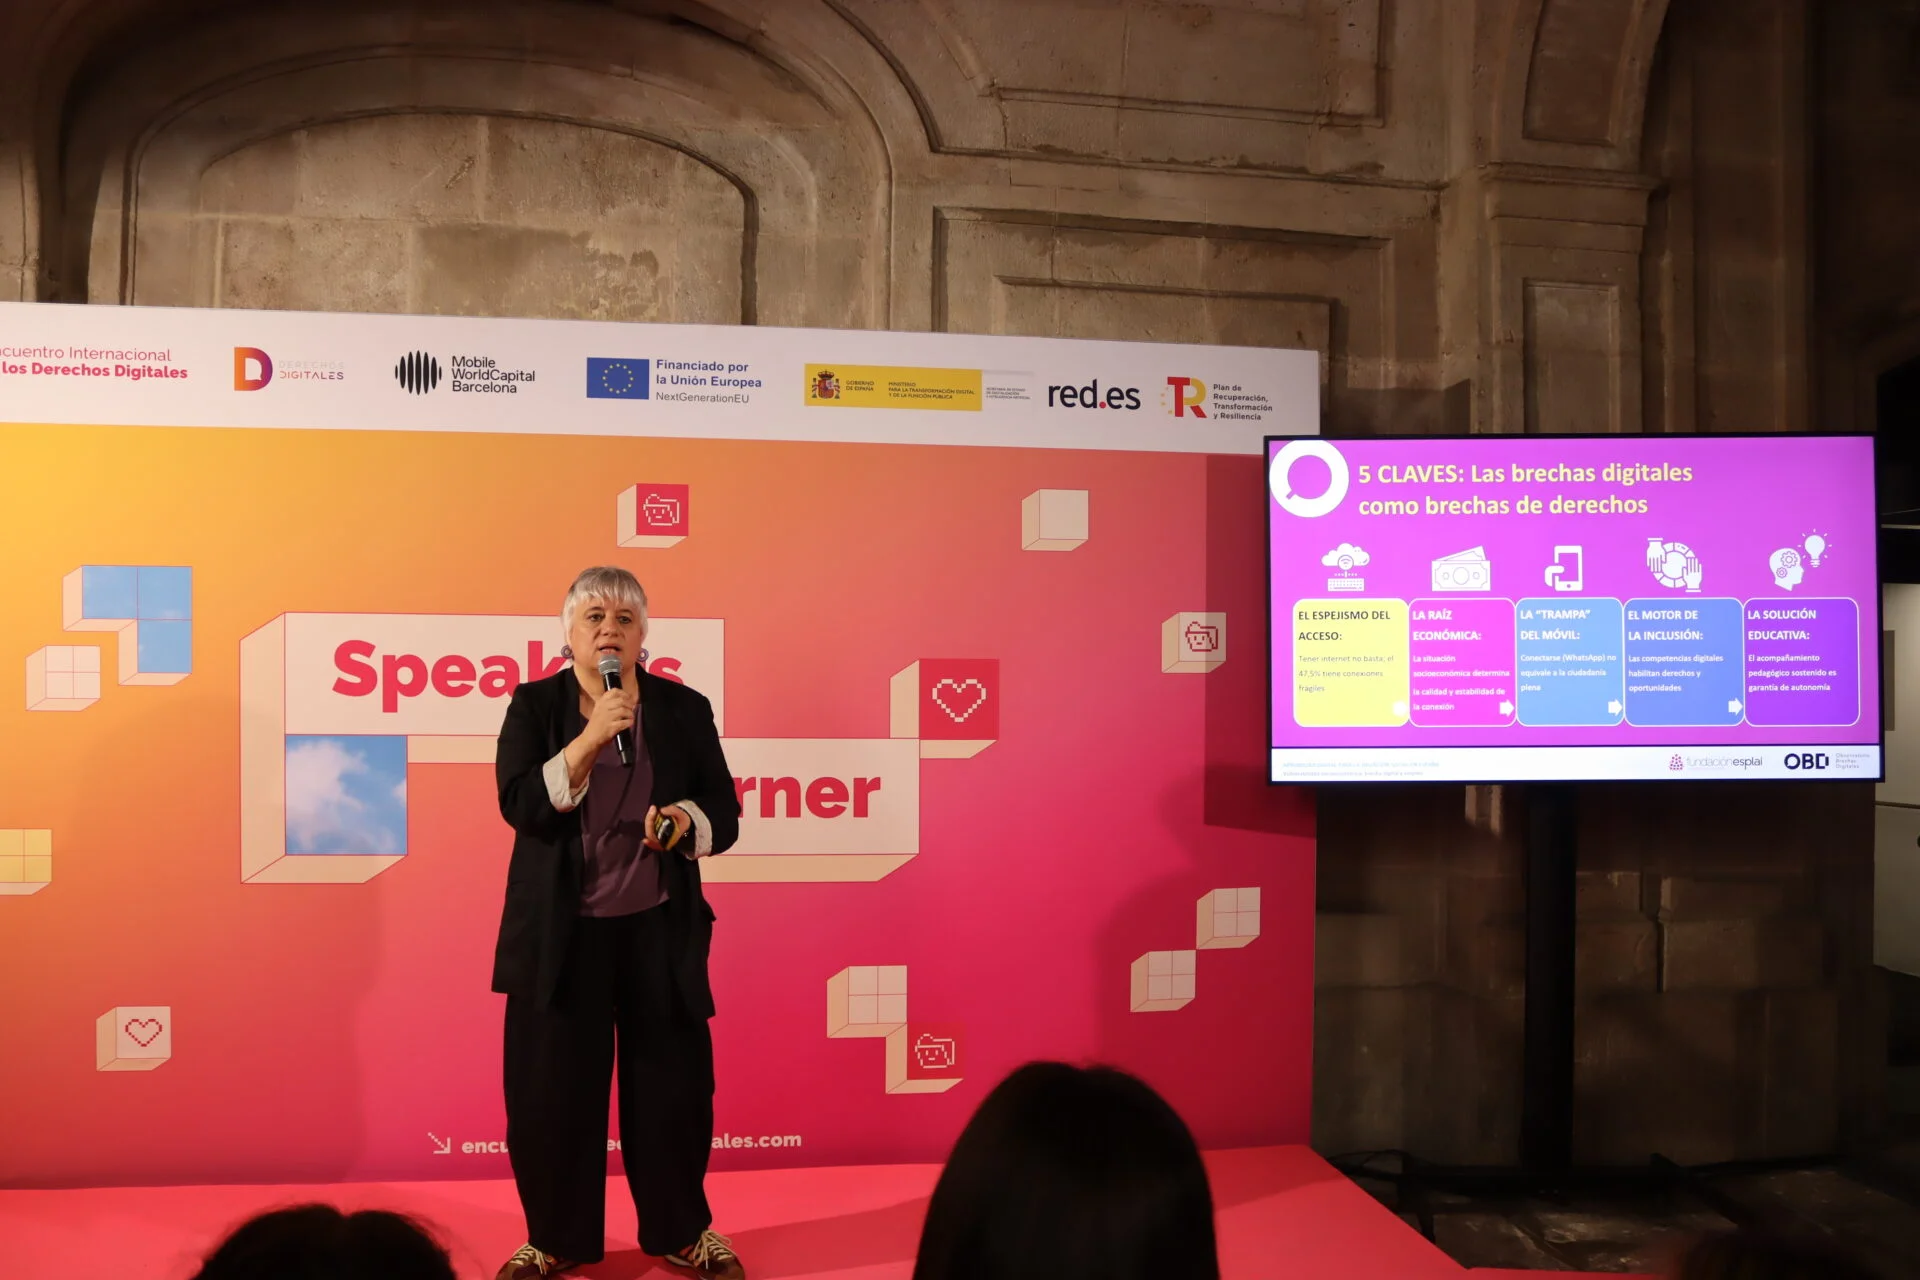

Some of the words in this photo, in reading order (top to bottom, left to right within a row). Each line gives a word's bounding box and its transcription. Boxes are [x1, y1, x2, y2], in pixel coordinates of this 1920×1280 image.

[69, 346, 172, 362] Internacional
[451, 355, 496, 369] Mobile
[656, 359, 725, 372] Financiado
[728, 363, 749, 374] por
[2, 361, 28, 375] los
[32, 362, 110, 377] Derechos
[115, 364, 188, 381] Digitales
[279, 370, 345, 380] DIGITALES
[451, 368, 536, 383] WorldCapital
[452, 380, 517, 394] Barcelona
[656, 375, 667, 385] la
[671, 375, 707, 386] Unión
[711, 376, 762, 389] Europea
[1213, 383, 1230, 391] Plan
[656, 391, 750, 404] NextGenerationEU
[1048, 378, 1141, 410] red.es
[1213, 392, 1269, 403] Recuperación,
[1213, 402, 1273, 412] Transformación
[1220, 412, 1262, 421] Resiliencia
[1358, 465, 1372, 484] 5
[1377, 464, 1465, 484] CLAVES:
[1471, 464, 1506, 483] Las
[1511, 462, 1597, 483] brechas
[1601, 461, 1694, 487] digitales
[1358, 499, 1420, 515] como
[1425, 495, 1512, 515] brechas
[1515, 495, 1544, 515] de
[1549, 494, 1649, 515] derechos
[1298, 611, 1310, 620] EL
[1312, 610, 1369, 620] ESPEJISMO
[1371, 610, 1391, 620] DEL
[1412, 610, 1426, 620] LA
[1428, 608, 1453, 620] RAÍZ
[1520, 610, 1534, 620] LA
[1628, 611, 1640, 620] EL
[1642, 610, 1682, 620] MOTOR
[1684, 610, 1699, 620] DE
[1747, 610, 1761, 620] LA
[1762, 607, 1817, 620] SOLUCIÓN
[1298, 631, 1343, 641] ACCESO:
[1413, 628, 1482, 641] ECONÓMICA:
[1520, 630, 1540, 640] DEL
[1542, 627, 1580, 640] MÓVIL:
[1628, 631, 1641, 640] LA
[1643, 628, 1704, 641] INCLUSIÓN:
[1748, 630, 1811, 640] EDUCATIVA:
[1520, 654, 1561, 662] Conectarse
[1562, 653, 1606, 663] (WhatsApp)
[1641, 655, 1692, 663] competencias
[1693, 654, 1724, 663] digitales
[1748, 654, 1755, 662] El
[1756, 653, 1820, 663] acompañamiento
[332, 639, 684, 713] Speaks
[1413, 669, 1471, 677] socioeconómica
[1472, 669, 1510, 677] determina
[1520, 669, 1552, 677] equivale
[1628, 669, 1660, 677] habilitan
[1661, 669, 1695, 677] derechos
[1748, 669, 1790, 678] pedagógico
[1791, 668, 1827, 676] sostenido
[1413, 688, 1420, 696] la
[1421, 688, 1447, 696] calidad
[1455, 688, 1494, 696] estabilidad
[1496, 688, 1505, 696] de
[1520, 684, 1541, 692] plena
[1628, 684, 1682, 693] oportunidades
[1748, 684, 1779, 693] garantía
[1780, 683, 1790, 691] de
[1791, 683, 1831, 691] autonomía
[1421, 703, 1455, 711] conexión
[1784, 753, 1829, 770] OBD
